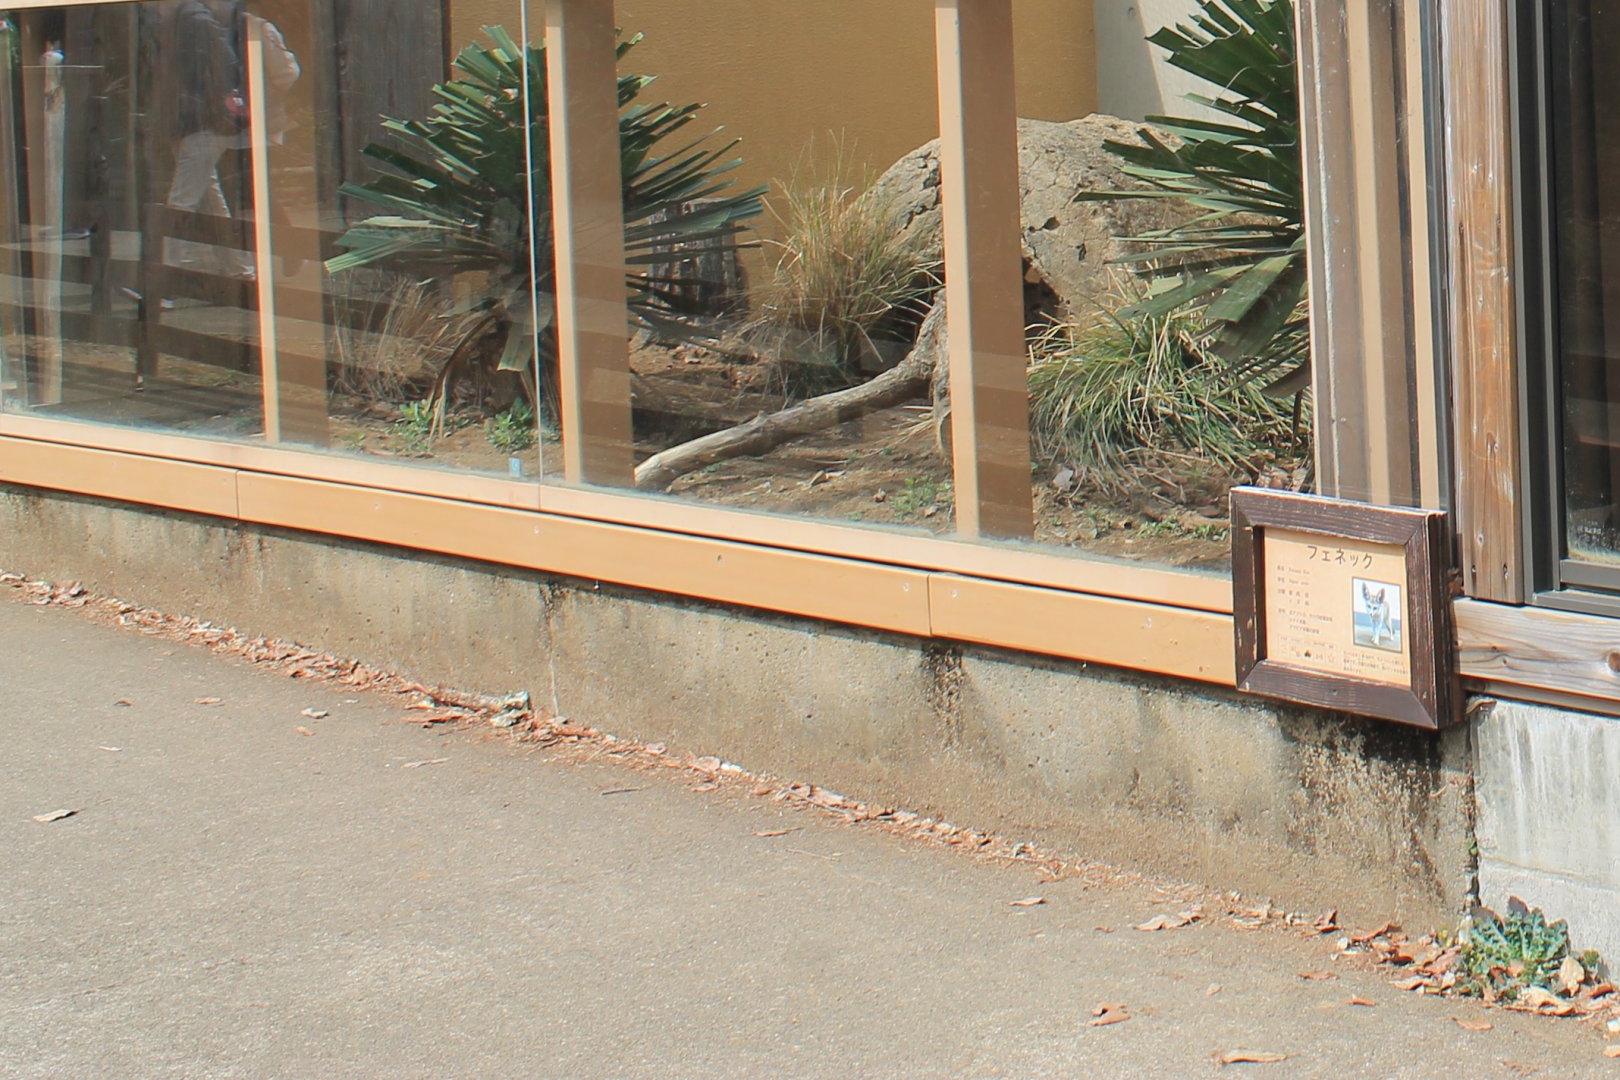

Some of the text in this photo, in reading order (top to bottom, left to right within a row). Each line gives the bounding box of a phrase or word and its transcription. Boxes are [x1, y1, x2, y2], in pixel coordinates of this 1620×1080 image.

[1306, 545, 1373, 569] フェネック
